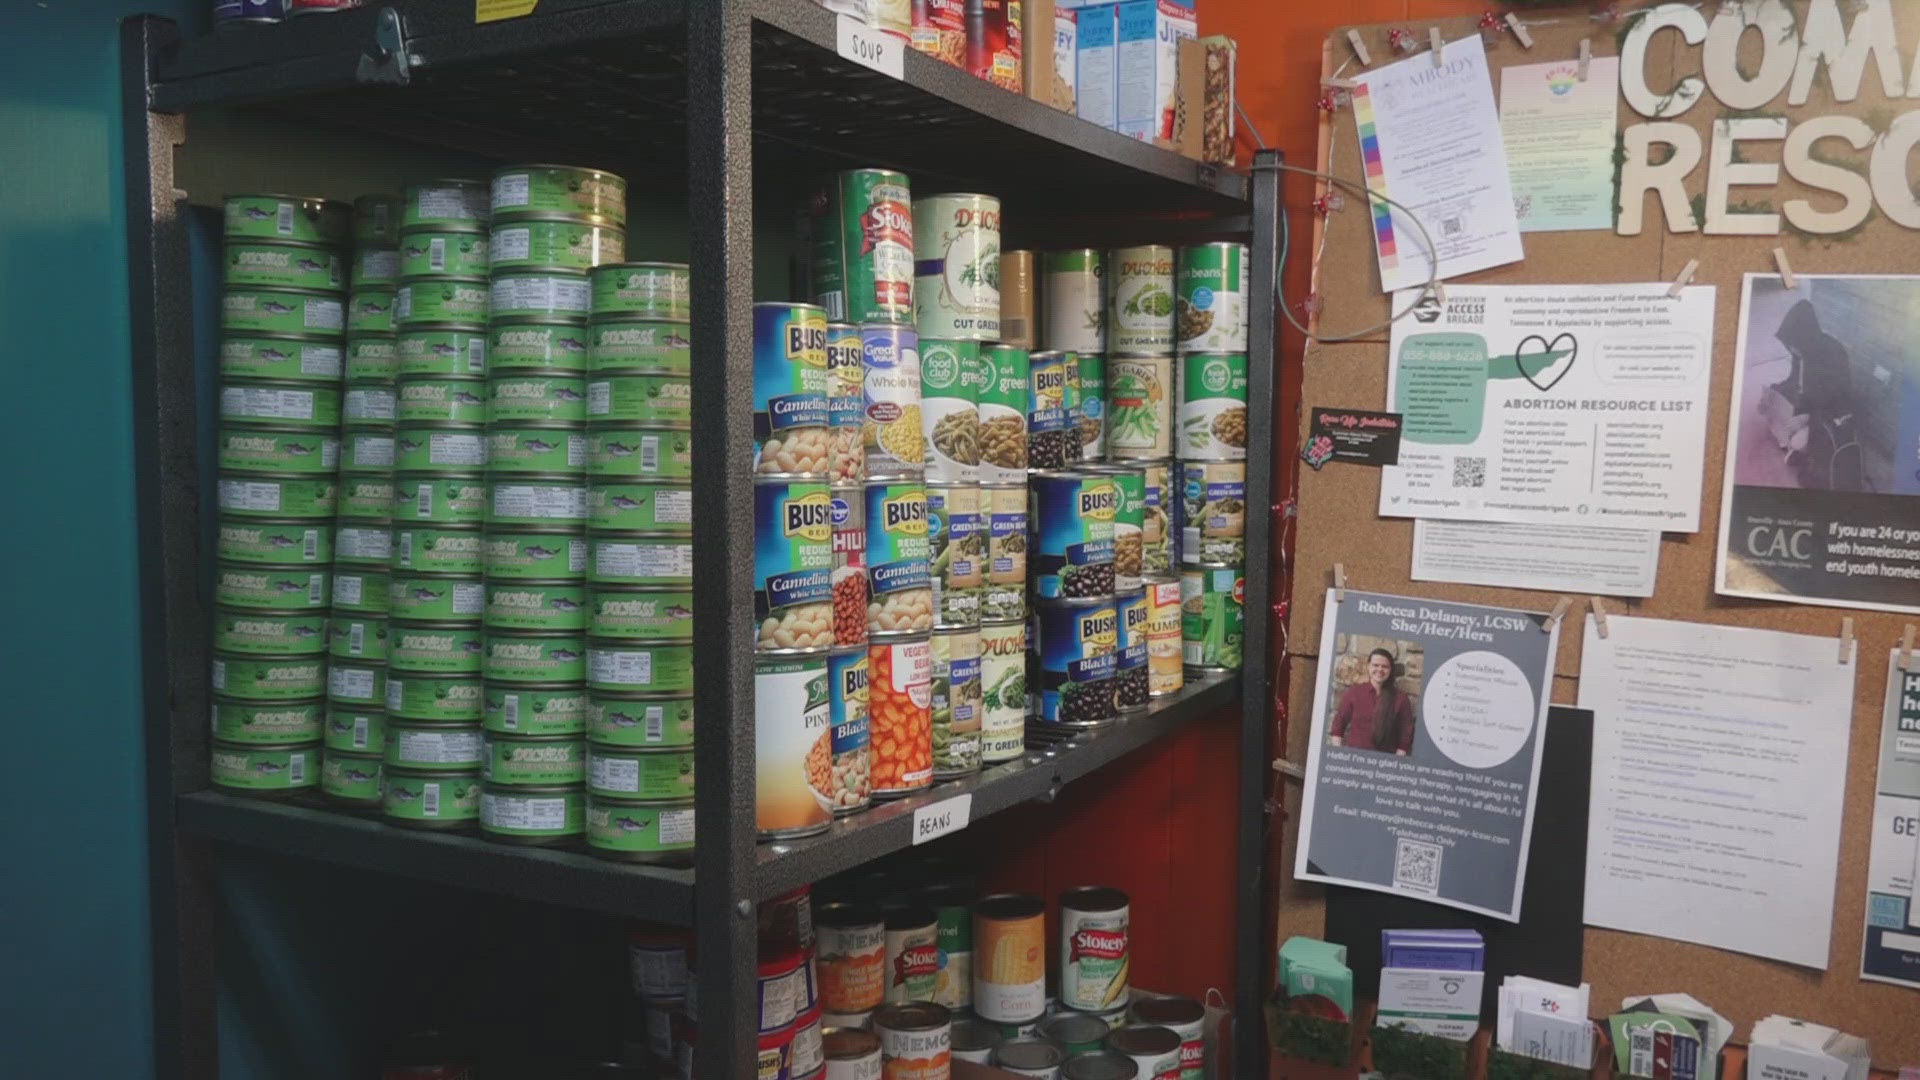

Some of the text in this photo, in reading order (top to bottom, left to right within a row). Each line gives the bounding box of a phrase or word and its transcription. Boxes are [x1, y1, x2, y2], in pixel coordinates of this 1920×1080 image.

[852, 35, 883, 63] SOUP
[1620, 0, 1920, 119] COM
[1192, 267, 1221, 278] beans
[1447, 304, 1485, 314] ACCESS
[1611, 305, 1641, 314] freedom
[953, 319, 973, 329] CUT
[1447, 315, 1485, 324] BRIGADE
[1604, 318, 1643, 328] supporting
[928, 357, 950, 368] food
[929, 367, 950, 379] club
[1000, 366, 1014, 375] cut
[872, 377, 906, 387] Whole
[1503, 399, 1693, 412] ABORTION RESOURCE LIST
[1829, 523, 1837, 535] If
[1838, 525, 1858, 539] you
[1859, 528, 1876, 538] are
[1878, 526, 1892, 539] 24
[1893, 530, 1905, 540] or
[1748, 525, 1812, 560] CAC
[1828, 541, 1850, 554] with
[1825, 560, 1846, 572] end
[1848, 563, 1878, 576] youth
[1358, 600, 1528, 632] Rebecca Delaney, LCSW
[1391, 618, 1493, 642] She/Her/Hers
[775, 664, 803, 672] SODIUM
[1080, 658, 1105, 671] Black
[995, 739, 1020, 751] GREEN
[1326, 751, 1351, 761] Hello!
[1352, 754, 1365, 762] I'm
[1379, 760, 1398, 769] glad
[1399, 763, 1415, 772] you
[1416, 766, 1430, 774] are
[1432, 768, 1463, 781] reading
[1465, 772, 1483, 783] this!
[1485, 776, 1492, 784] If
[1492, 779, 1507, 789] you
[1509, 782, 1523, 791] are
[1325, 764, 1511, 801] considering beginning therapy, reengaging in
[1332, 777, 1360, 789] simply
[1361, 782, 1375, 790] are
[1376, 784, 1407, 796] curious
[1409, 789, 1433, 800] about
[1435, 793, 1456, 804] what
[1458, 796, 1471, 807] it's
[1472, 800, 1482, 809] all
[1483, 803, 1509, 816] about,
[1511, 808, 1522, 818] I'd
[1333, 804, 1358, 816] Email:
[1375, 795, 1460, 818] love to talk with you.
[920, 812, 951, 836] BEANS
[1436, 835, 1456, 848] Only
